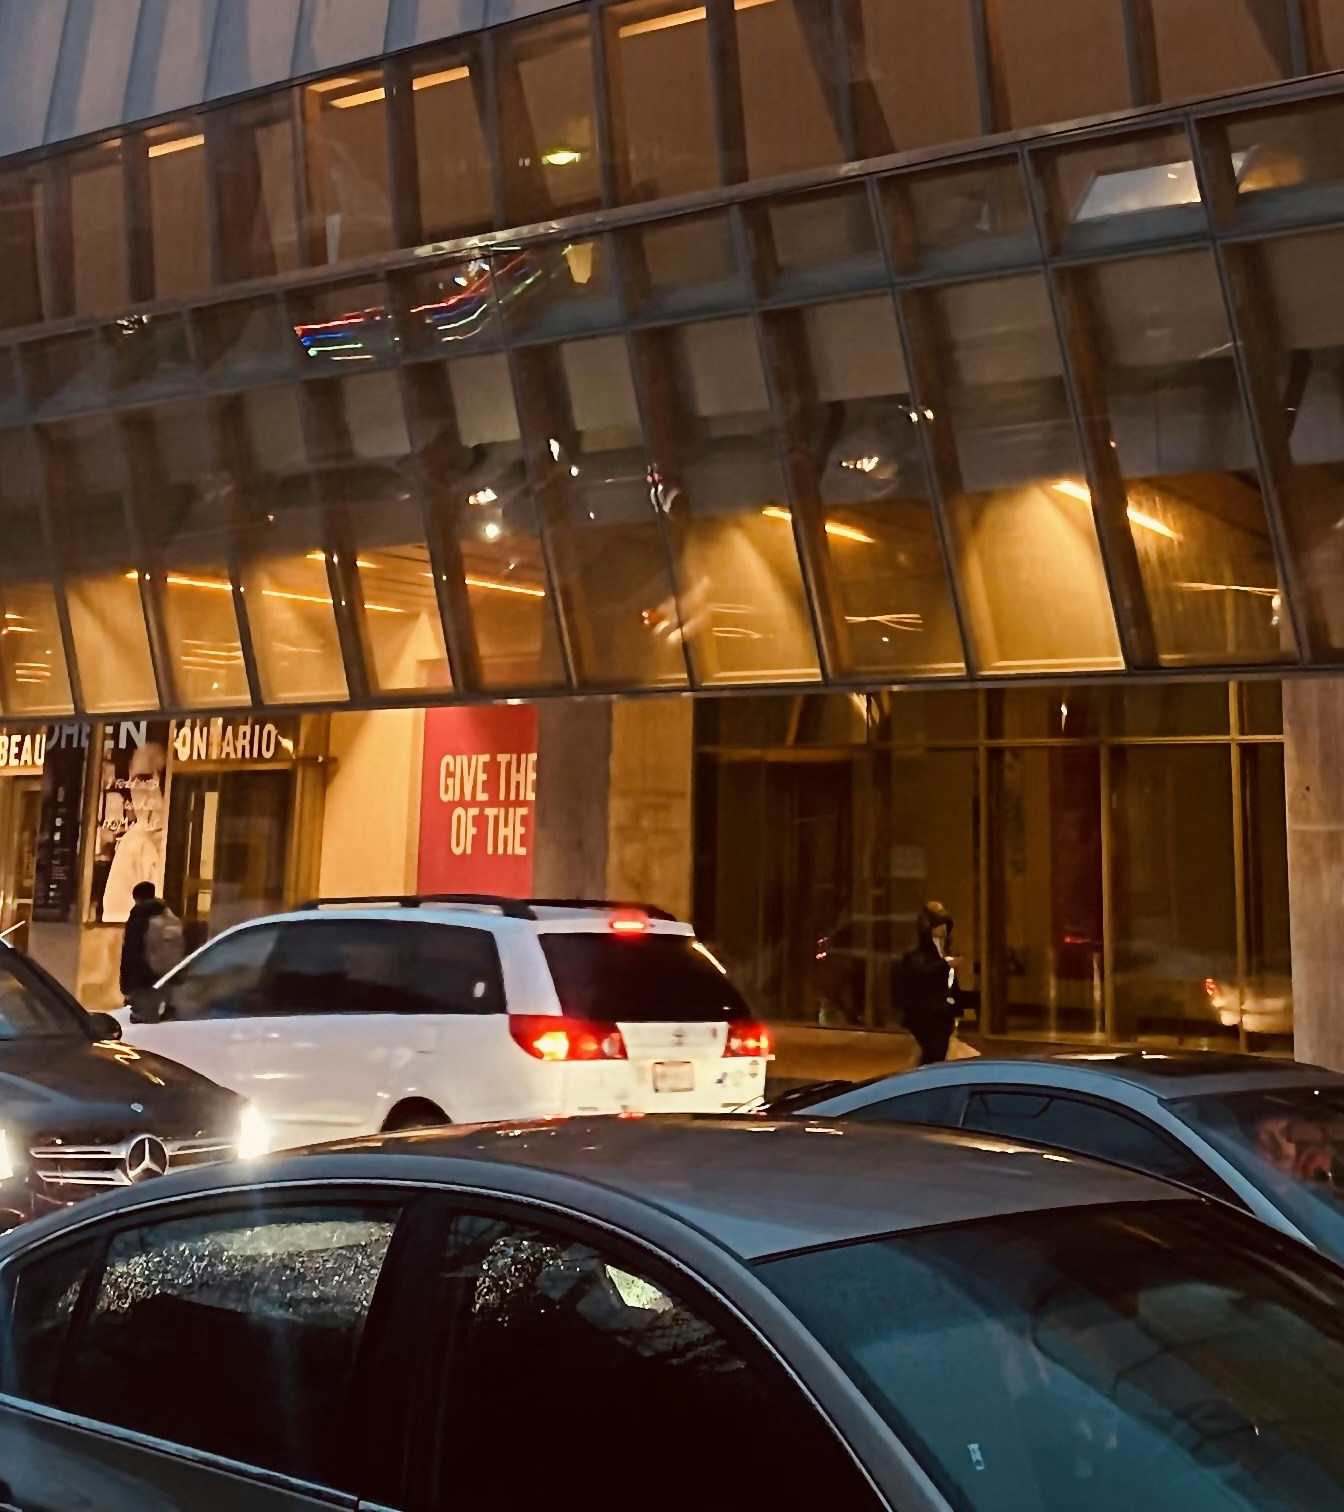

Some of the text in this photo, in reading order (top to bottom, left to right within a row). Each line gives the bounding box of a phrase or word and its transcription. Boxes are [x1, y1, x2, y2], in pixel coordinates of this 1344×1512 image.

[439, 752, 538, 803] GIVE THE
[450, 806, 529, 856] OF THE
